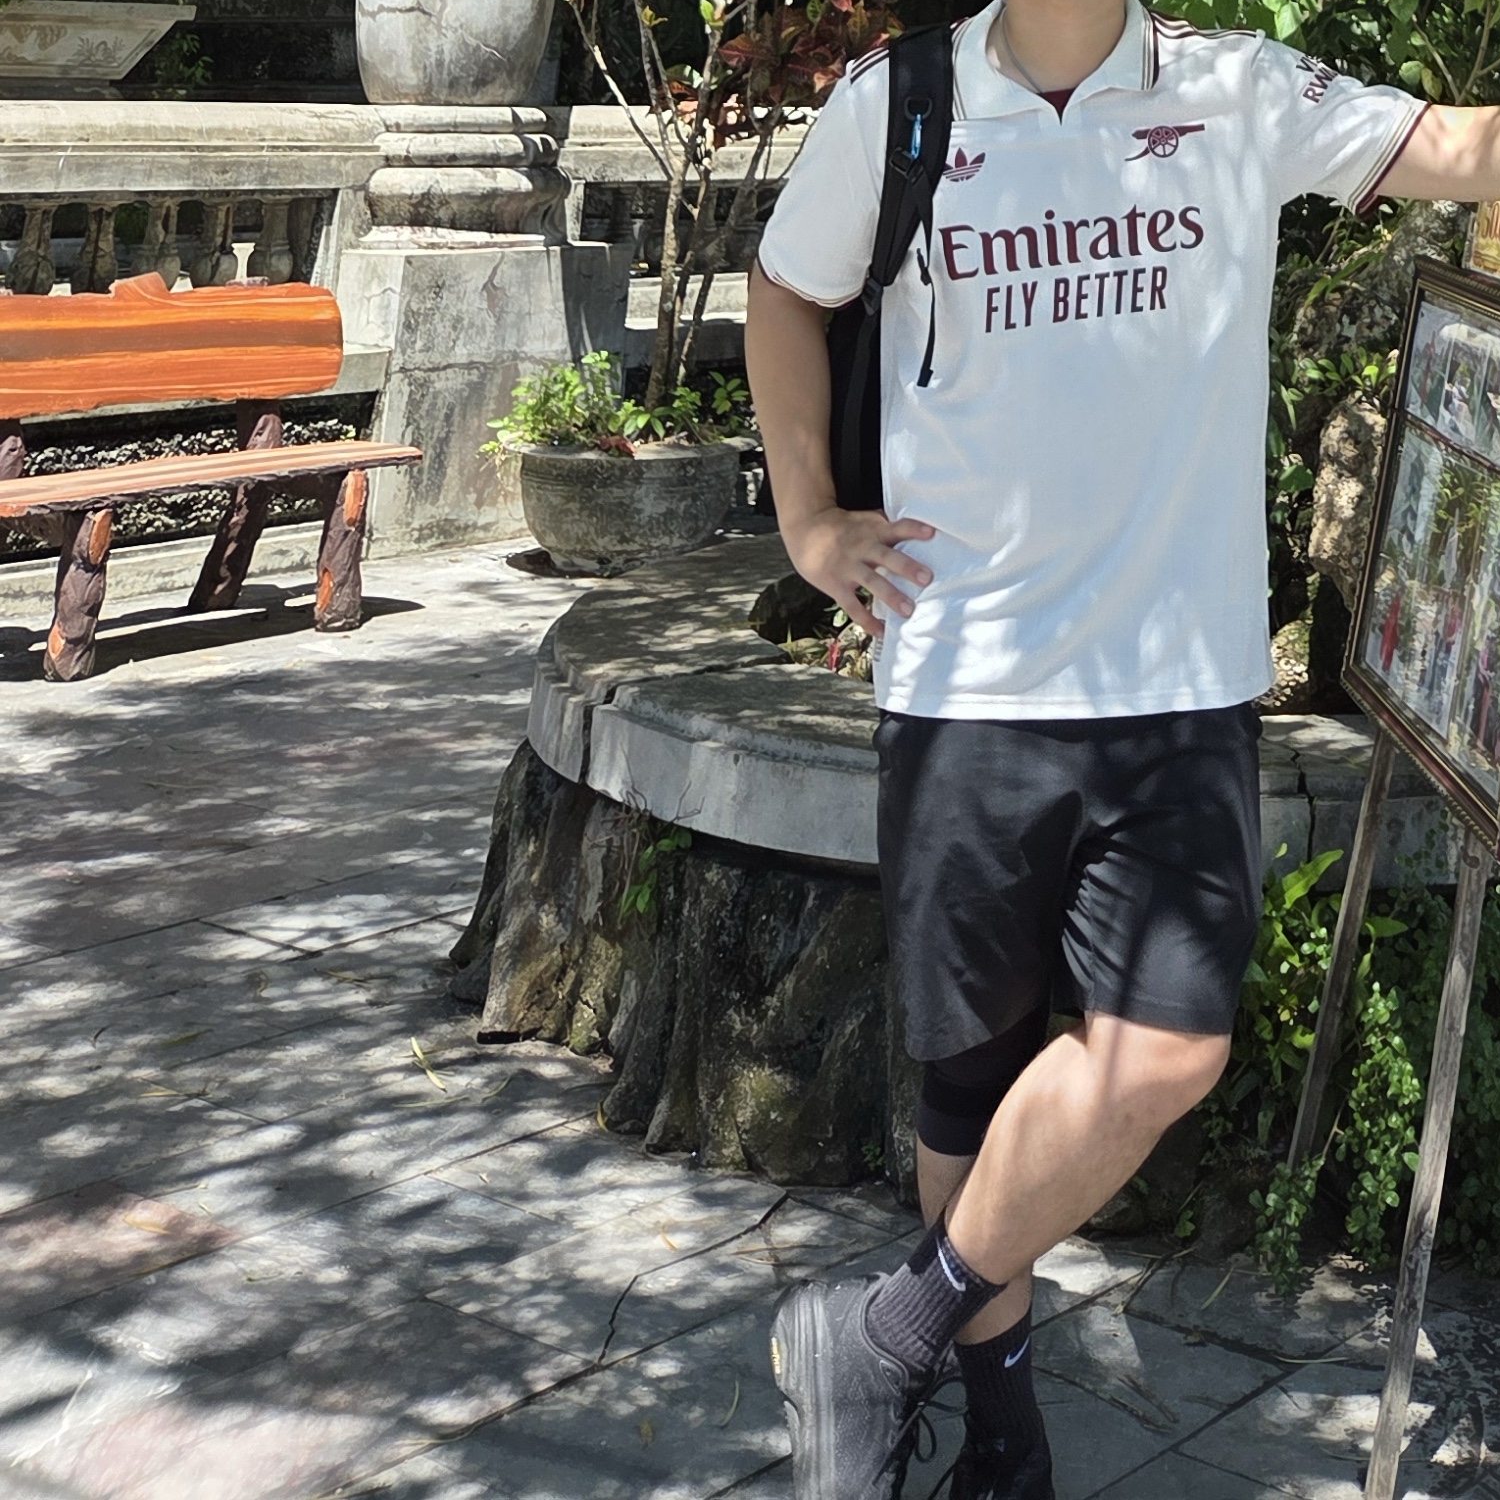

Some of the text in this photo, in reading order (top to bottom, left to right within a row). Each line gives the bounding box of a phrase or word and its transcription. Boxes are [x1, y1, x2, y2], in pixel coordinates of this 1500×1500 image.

[938, 204, 1204, 281] Emirates
[985, 265, 1168, 333] FLY BETTER
